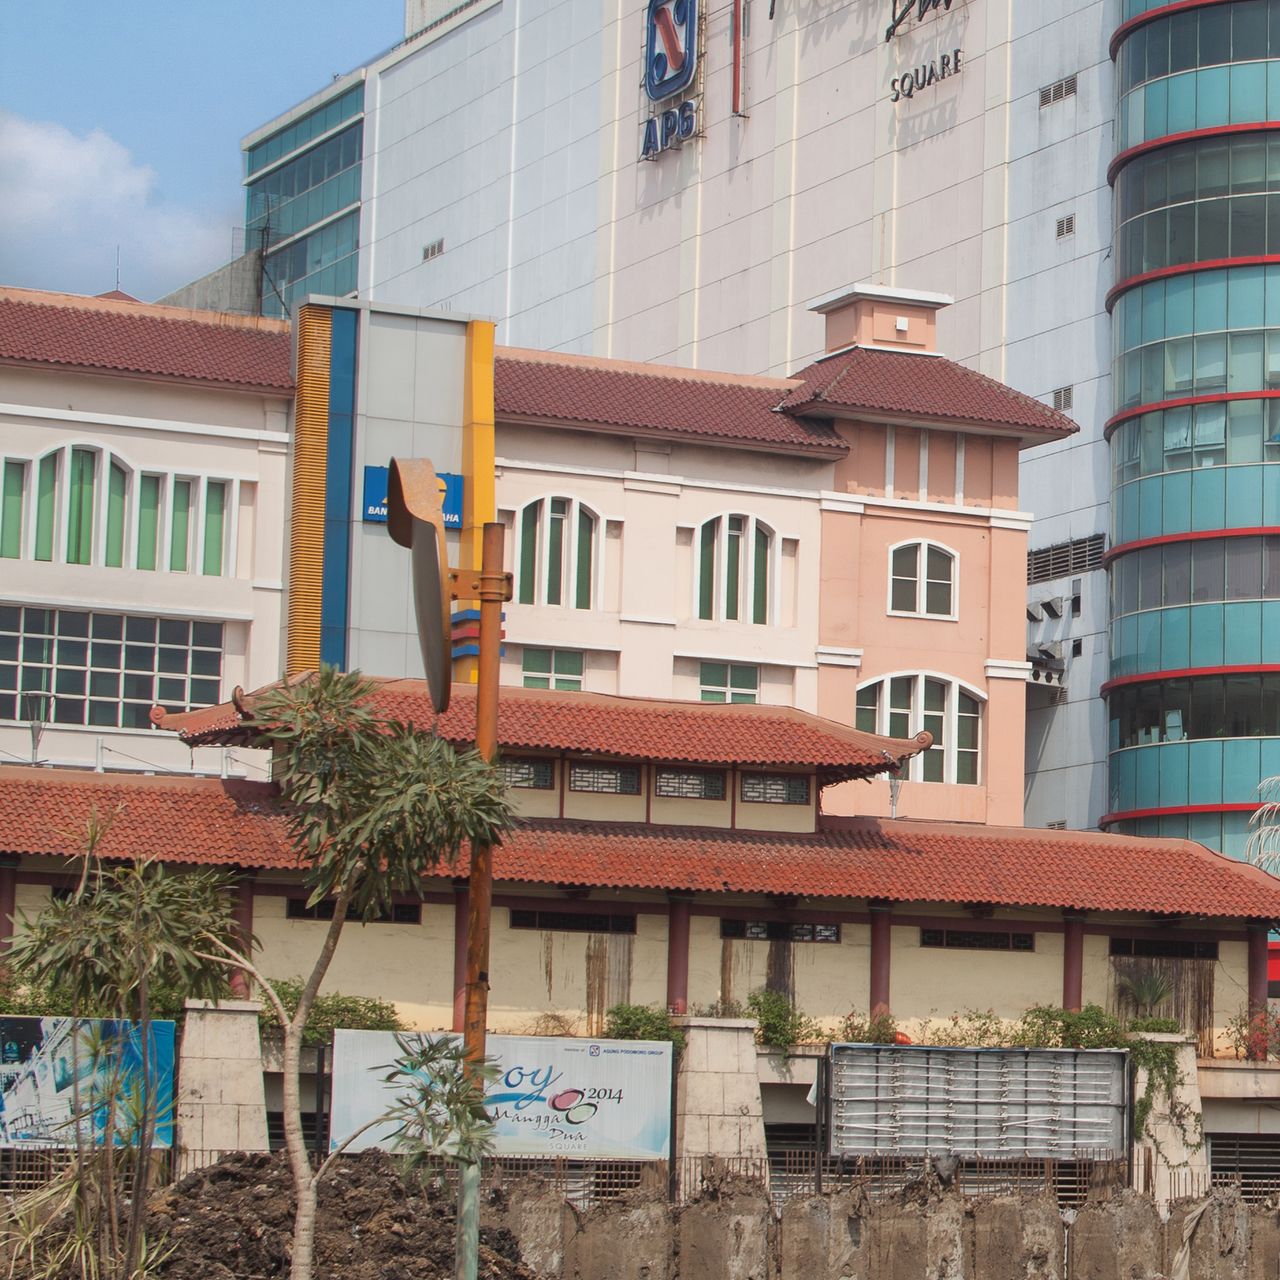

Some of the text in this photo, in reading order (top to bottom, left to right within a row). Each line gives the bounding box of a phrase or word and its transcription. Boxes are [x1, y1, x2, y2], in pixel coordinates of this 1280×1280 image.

[890, 48, 964, 103] SQUARE
[641, 100, 698, 157] APG
[368, 506, 388, 515] BAN
[586, 1087, 625, 1104] 2014
[492, 1106, 563, 1131] Mangga
[548, 1127, 588, 1142] Dua
[549, 1143, 589, 1151] SQUARE
